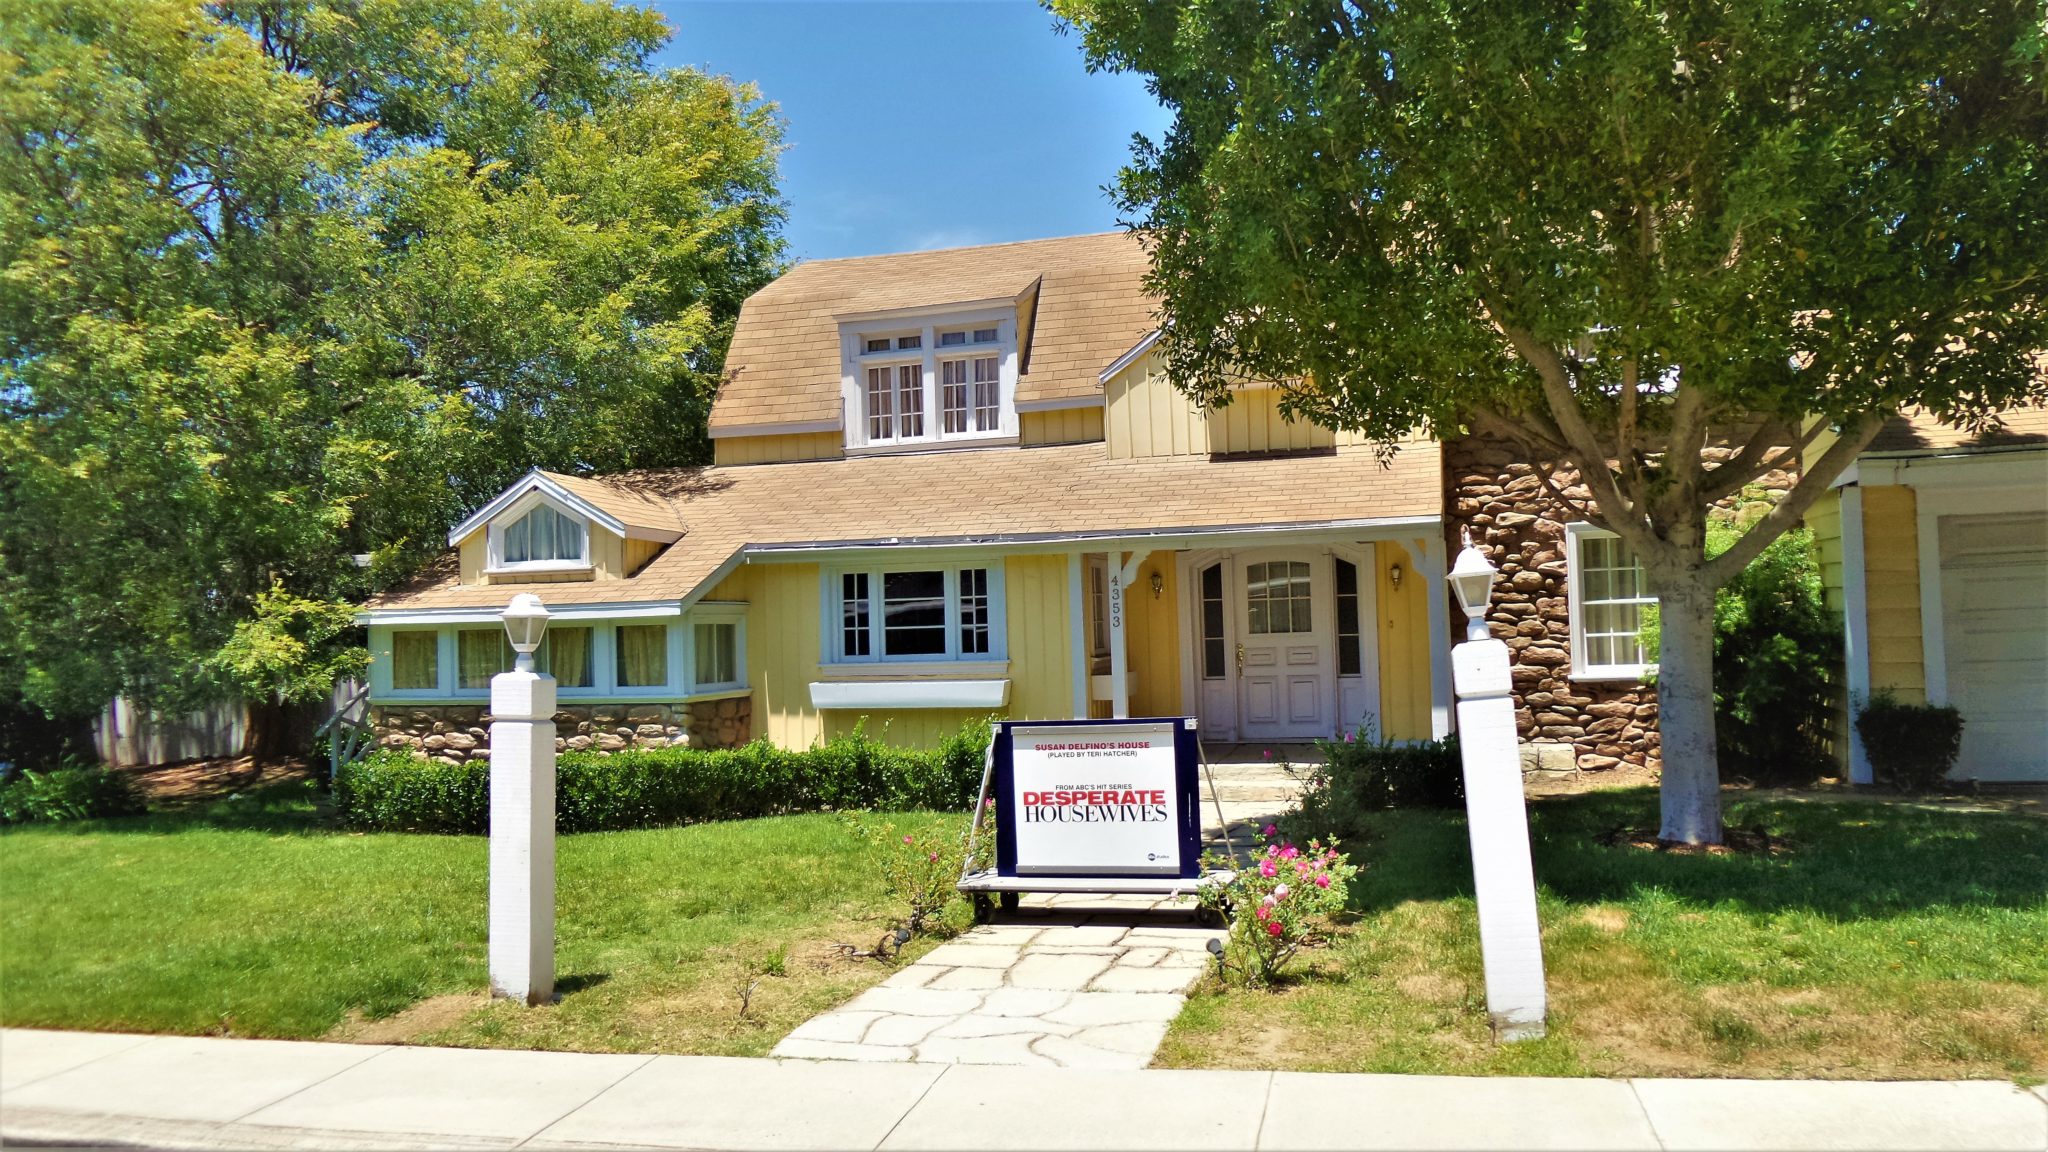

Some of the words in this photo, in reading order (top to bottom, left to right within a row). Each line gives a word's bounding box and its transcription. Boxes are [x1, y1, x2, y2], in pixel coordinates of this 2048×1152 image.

[1111, 575, 1120, 628] 4353
[1068, 742, 1115, 750] DELFINO'S
[1118, 741, 1150, 749] HOUSE
[1047, 751, 1075, 759] (PLAYED
[1023, 790, 1166, 806] DESPERATE
[1024, 804, 1168, 823] HOUSEWIVES
